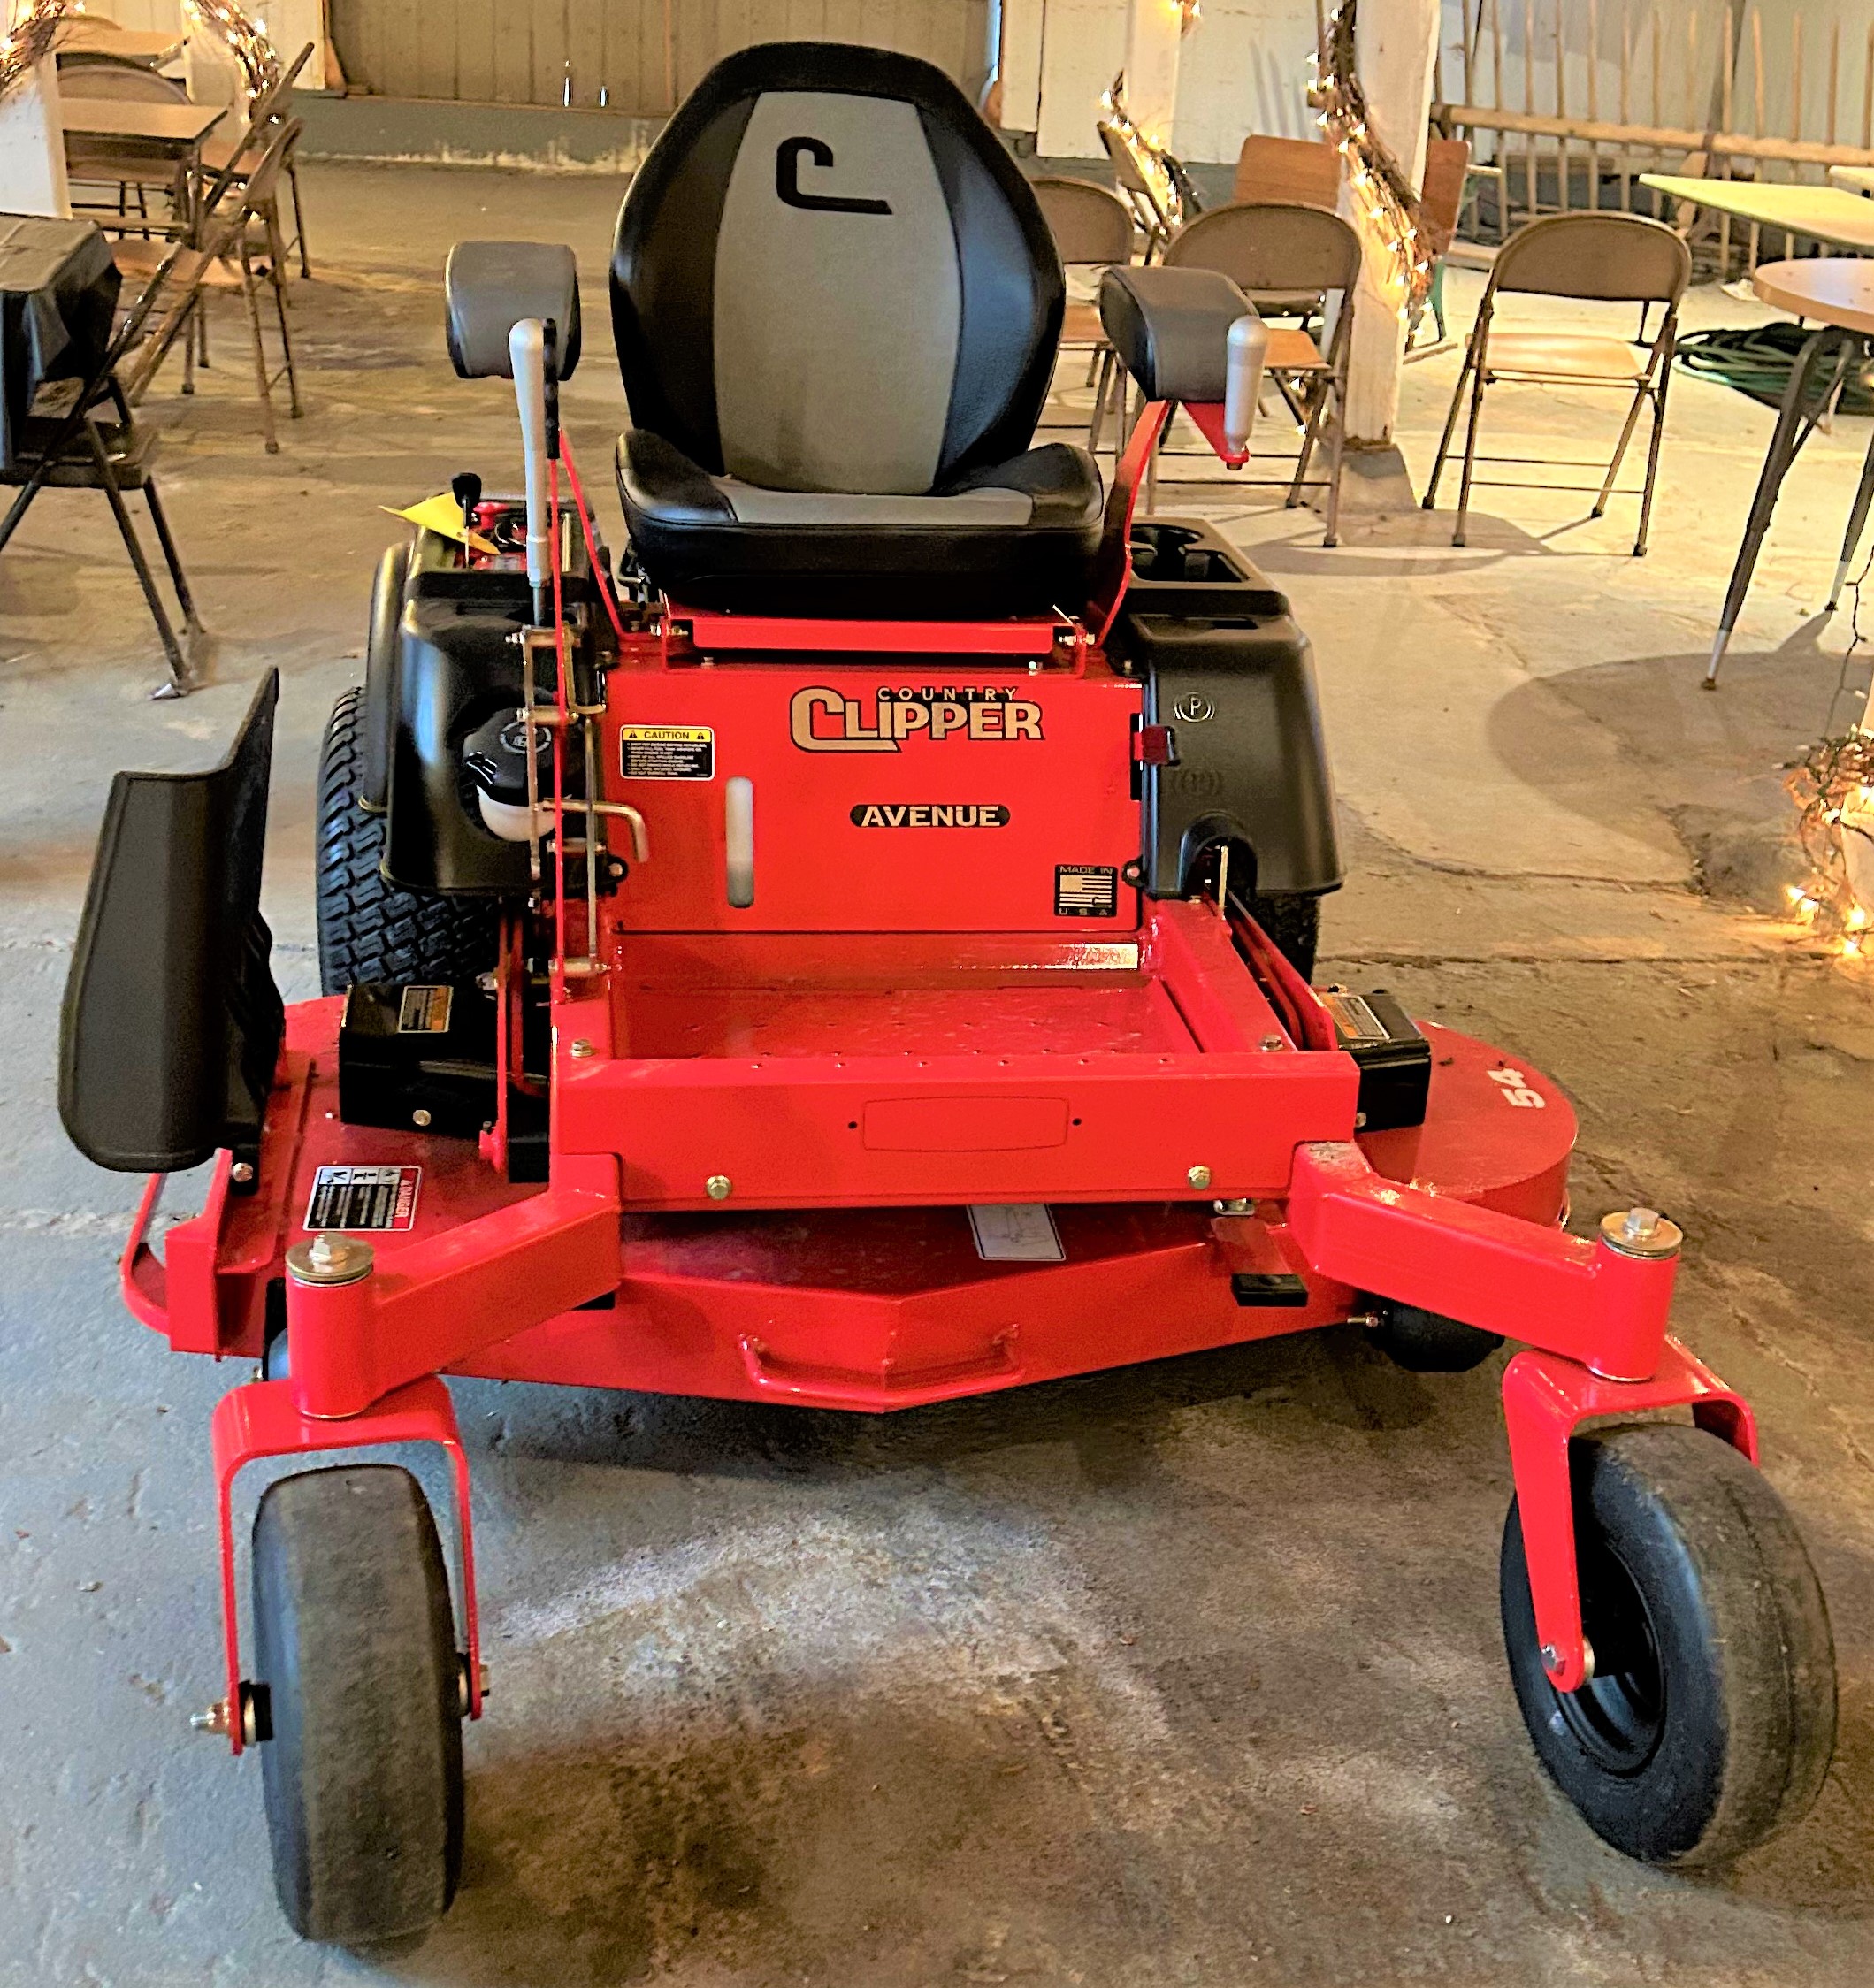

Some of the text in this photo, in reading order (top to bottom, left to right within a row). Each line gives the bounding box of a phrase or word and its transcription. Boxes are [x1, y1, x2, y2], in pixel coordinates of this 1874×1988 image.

[876, 687, 1018, 701] COUNTRY
[790, 685, 1045, 753] CLIPPER
[644, 730, 690, 740] CAUTION
[861, 805, 1001, 827] AVENUE
[1059, 866, 1113, 875] MADE IN
[1487, 1067, 1546, 1109] 54
